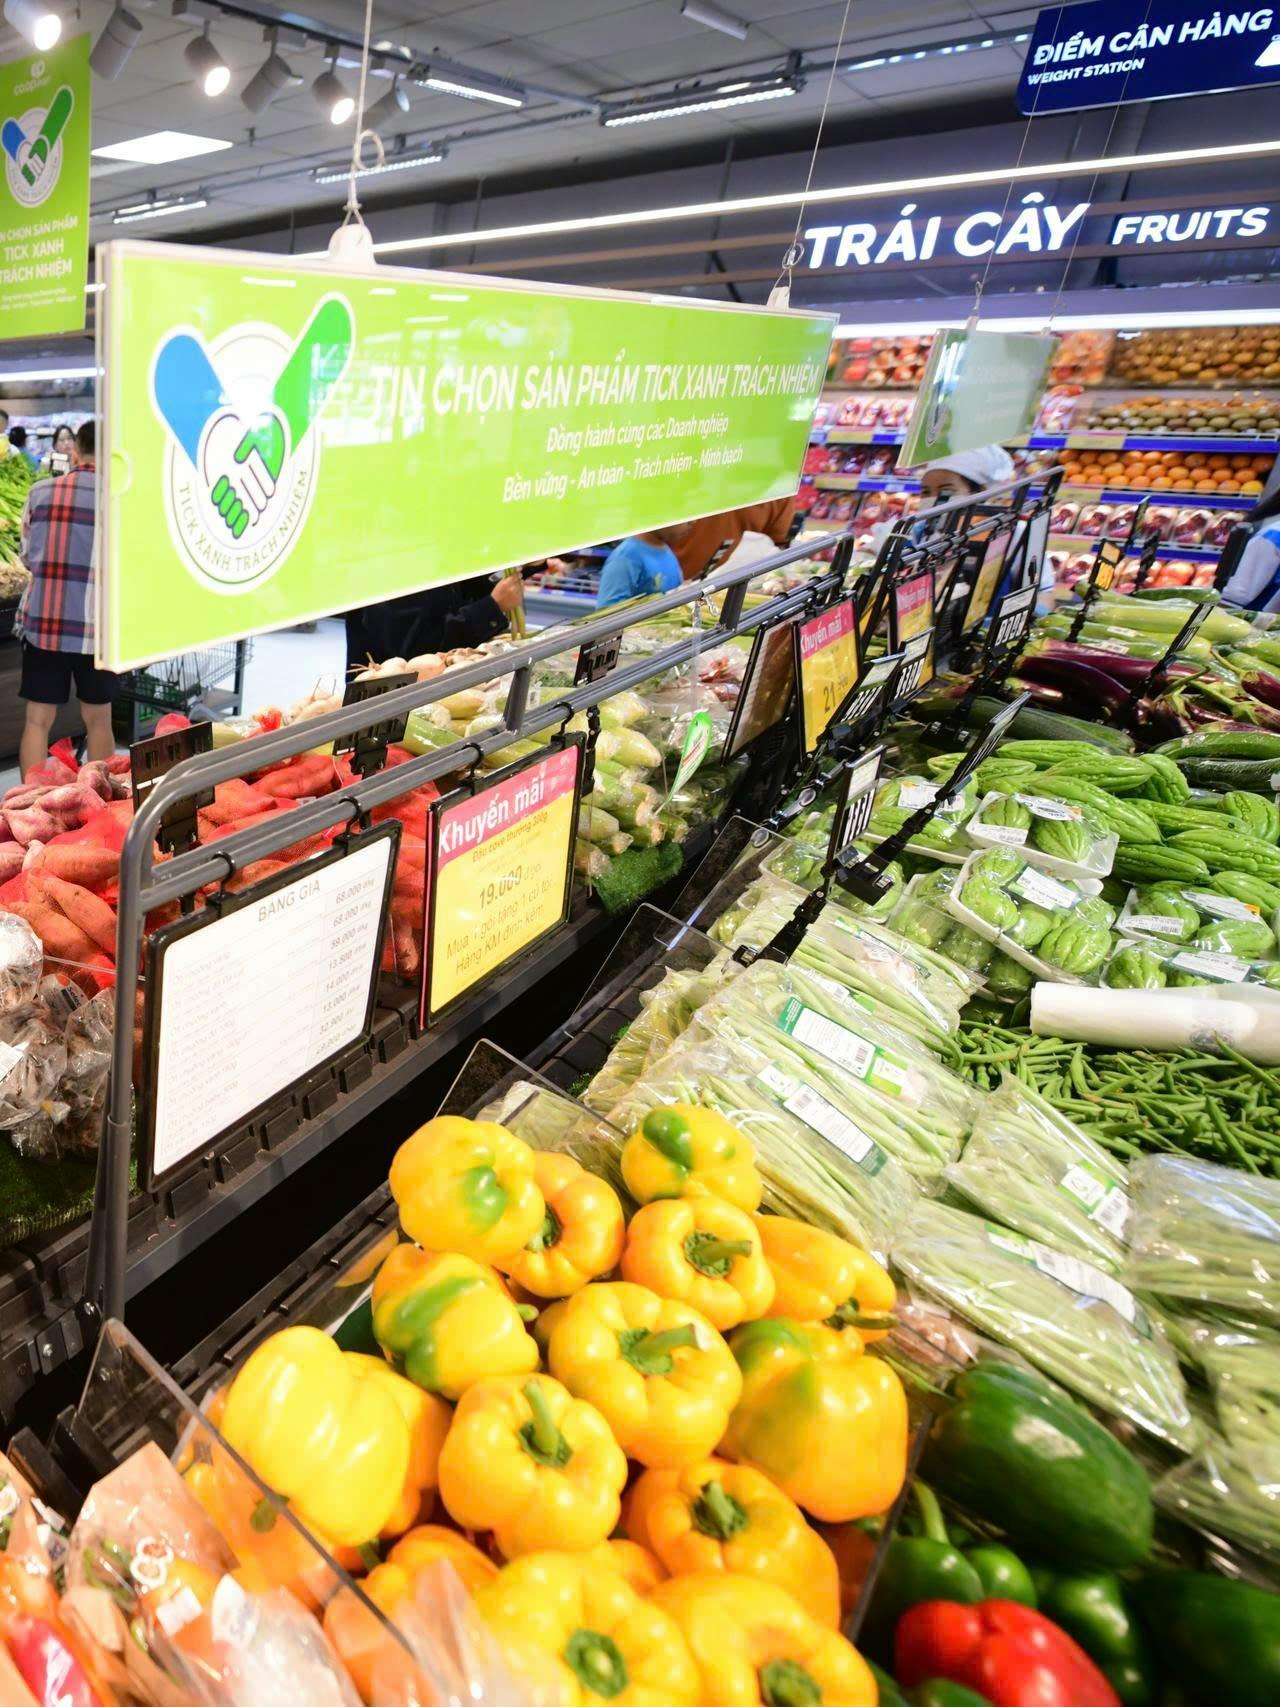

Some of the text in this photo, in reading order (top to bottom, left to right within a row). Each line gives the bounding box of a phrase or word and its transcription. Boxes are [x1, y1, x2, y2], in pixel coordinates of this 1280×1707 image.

[1033, 8, 1273, 66] ĐIỂM CÂN HÀNG
[1027, 58, 1145, 86] WEIGHT STATION
[3, 237, 65, 262] TICK XANH
[803, 191, 1271, 270] TRÁI CÂY FRUITS
[372, 365, 425, 420] TIN
[432, 364, 518, 424] CHỌN
[523, 351, 572, 410] SẢN
[576, 347, 639, 403] PHẨM
[643, 364, 683, 402] TICK
[681, 364, 730, 400] XANH
[731, 355, 780, 397] TRÁCH
[545, 424, 583, 457] Đồng
[584, 419, 615, 448] hành
[646, 418, 666, 441] các
[666, 413, 697, 439] Doanh
[503, 471, 532, 503] Bền
[534, 470, 569, 500] vững
[577, 465, 596, 490] An
[597, 461, 625, 485] toàn
[632, 453, 664, 480] Trách
[663, 451, 693, 478] nhiệm
[698, 447, 721, 469] Minh
[823, 683, 836, 714] 21
[439, 797, 509, 856] Khuyến
[514, 776, 546, 815] mãi
[480, 864, 522, 909] 19.000
[447, 935, 469, 961] Mua
